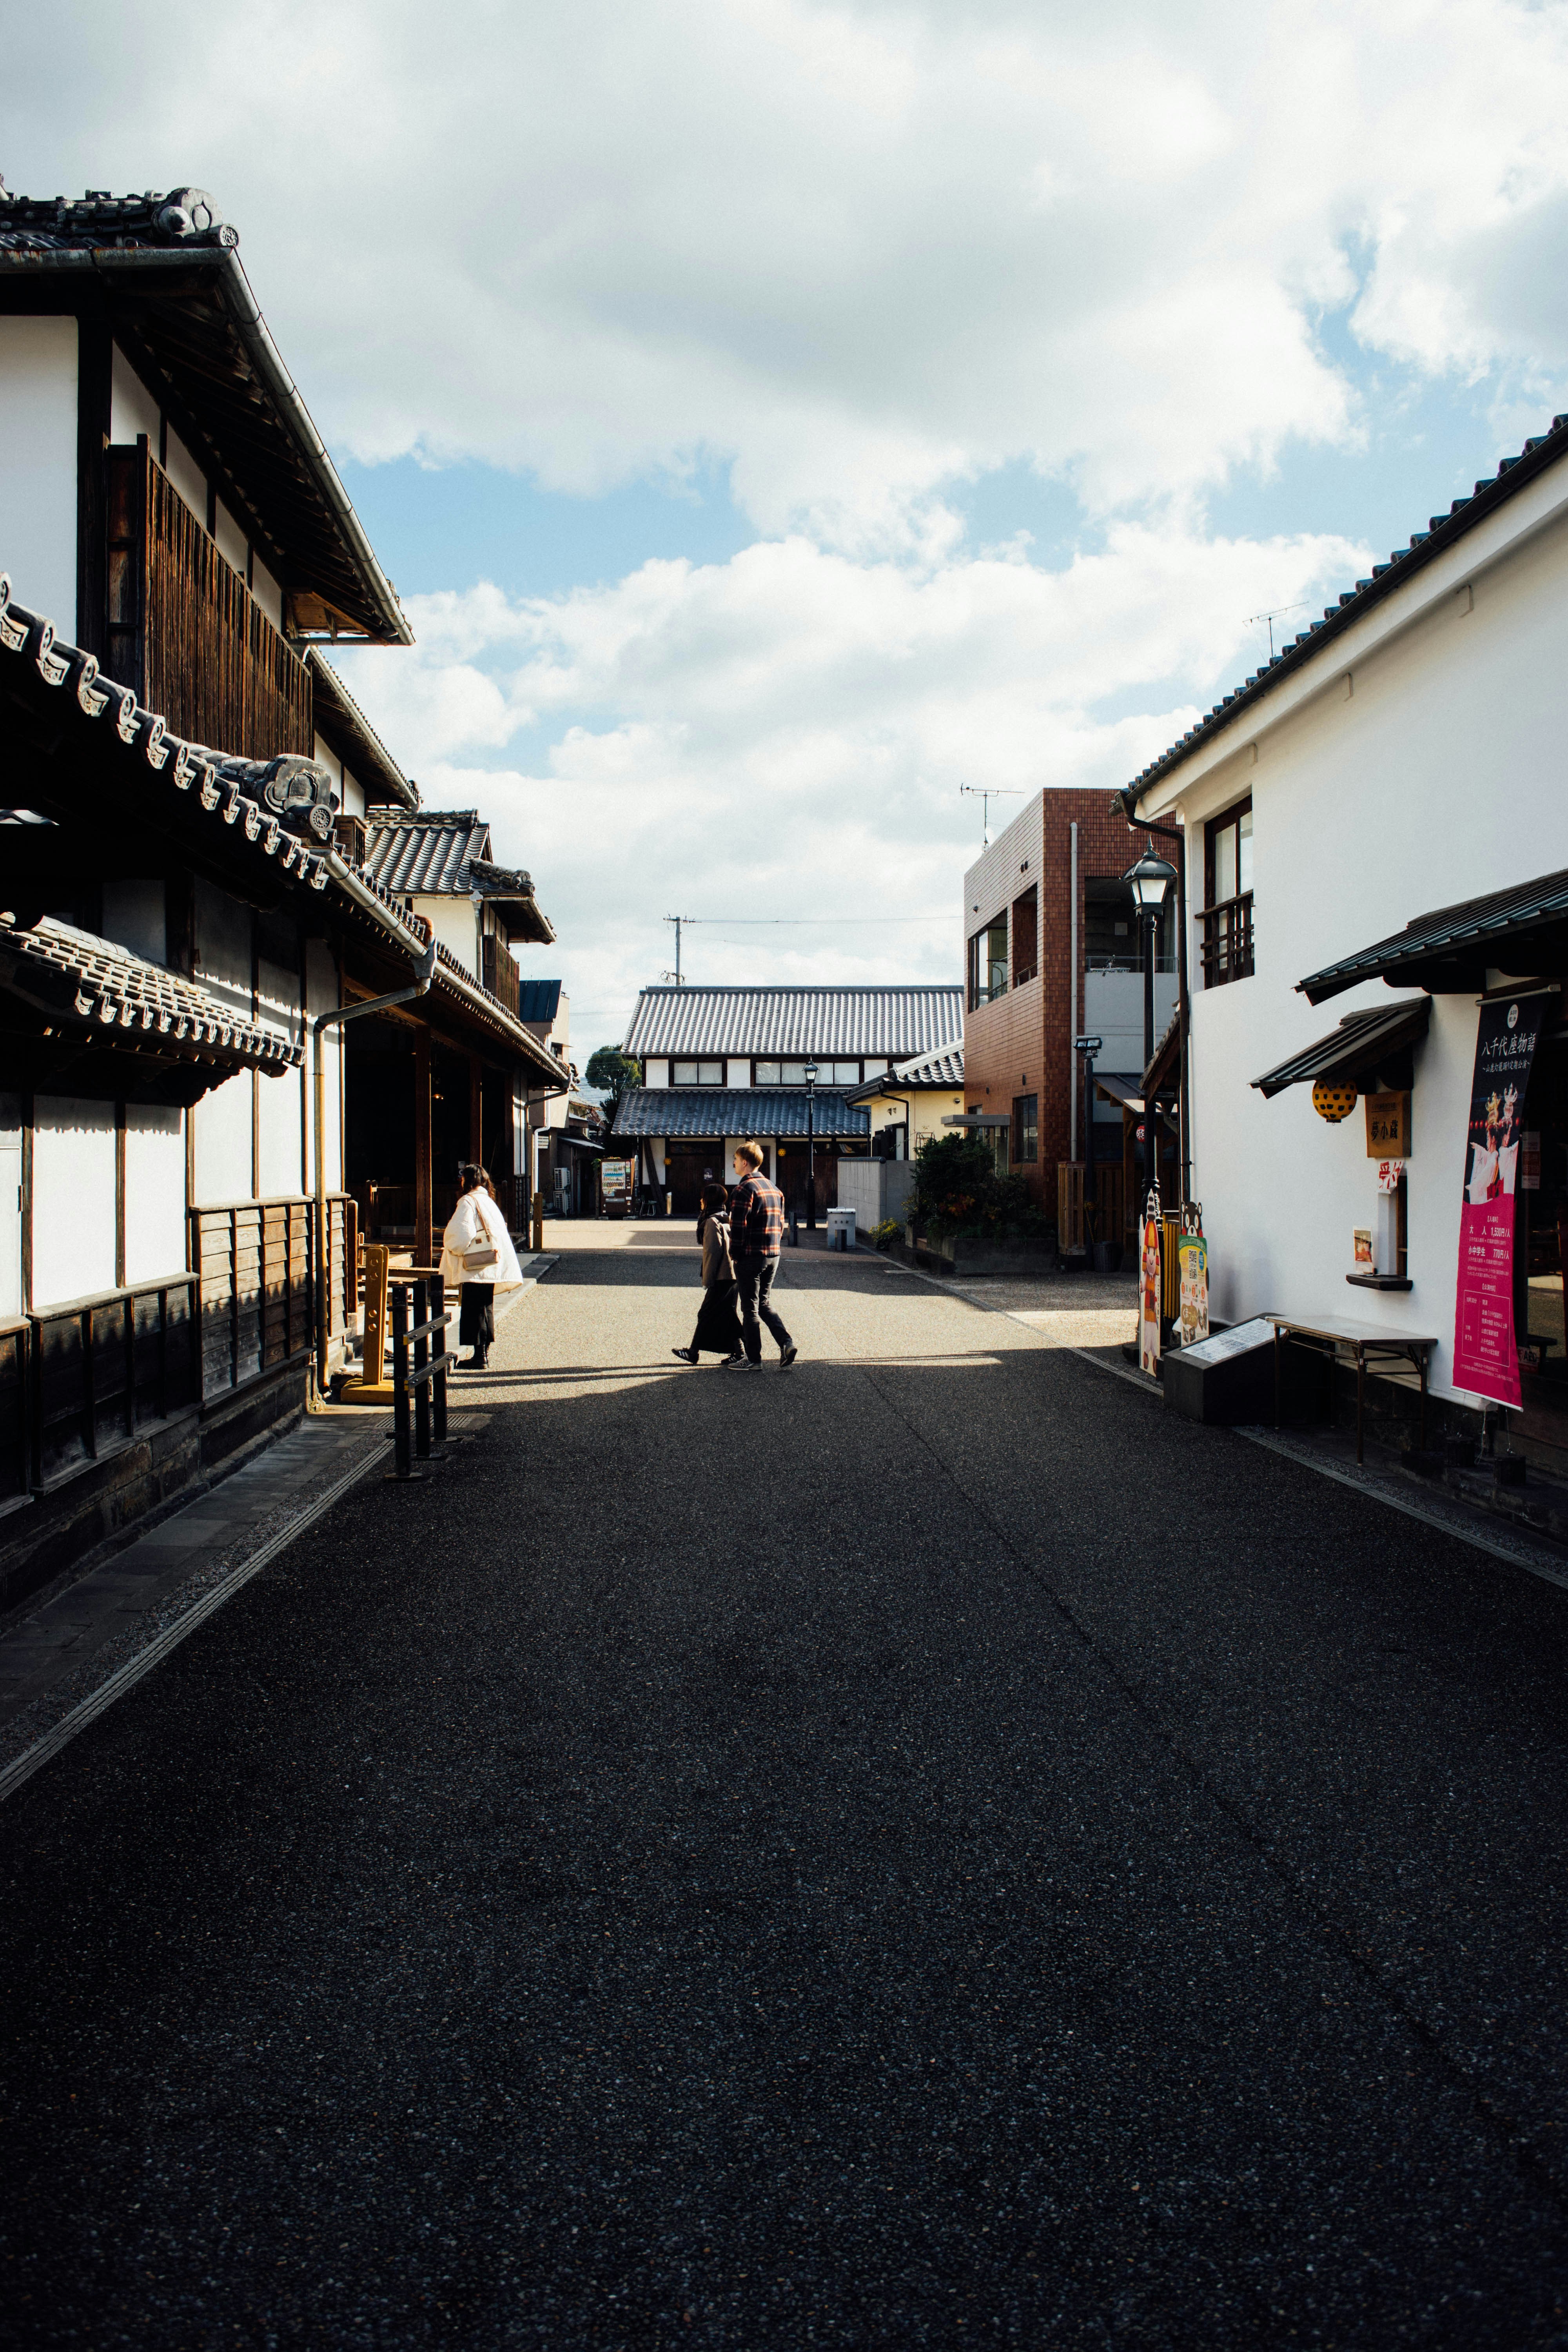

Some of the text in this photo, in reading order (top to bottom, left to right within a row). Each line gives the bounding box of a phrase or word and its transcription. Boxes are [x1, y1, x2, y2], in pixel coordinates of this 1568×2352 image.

[1481, 1032, 1536, 1058] 八千代座物語
[1371, 1120, 1398, 1141] 夢小蔵
[1379, 1161, 1401, 1189] 受付
[1491, 1227, 1510, 1238] 1,530円/人
[1468, 1246, 1509, 1259] 小中学生 770円/人
